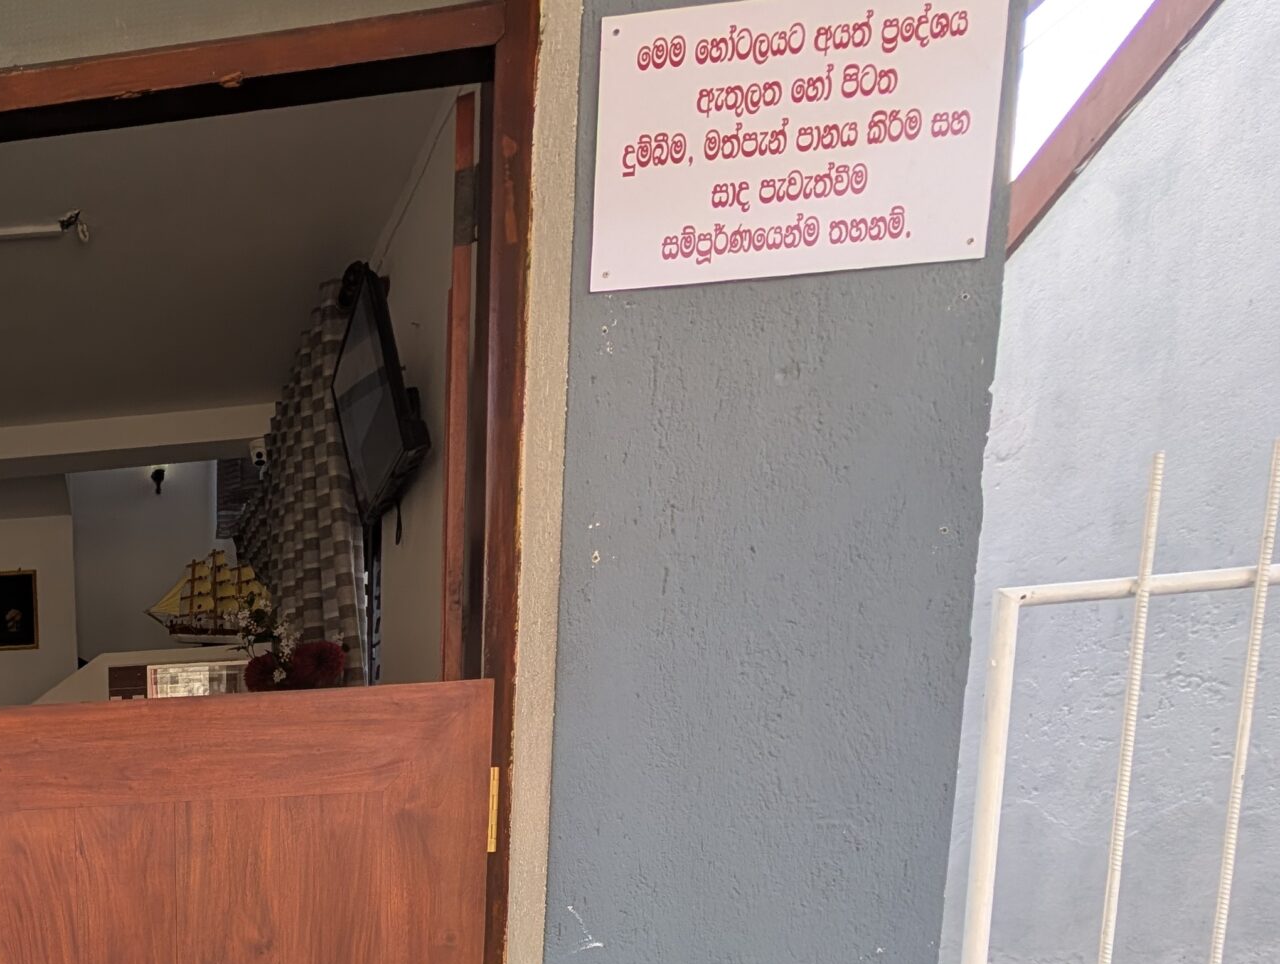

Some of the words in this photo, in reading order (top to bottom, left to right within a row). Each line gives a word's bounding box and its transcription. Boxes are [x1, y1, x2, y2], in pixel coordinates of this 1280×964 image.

[637, 35, 686, 71] මෙම
[695, 22, 806, 65] හෝටලයට
[814, 9, 874, 56] අයත්
[696, 80, 783, 118] ඇතුලත
[791, 63, 834, 103] හෝ
[841, 63, 898, 98] පිටත
[703, 117, 789, 161] මත්පැන්
[796, 121, 858, 152] පානය
[931, 109, 971, 138] සහ
[711, 181, 751, 213] සාද
[759, 162, 868, 204] පැවැත්වීම
